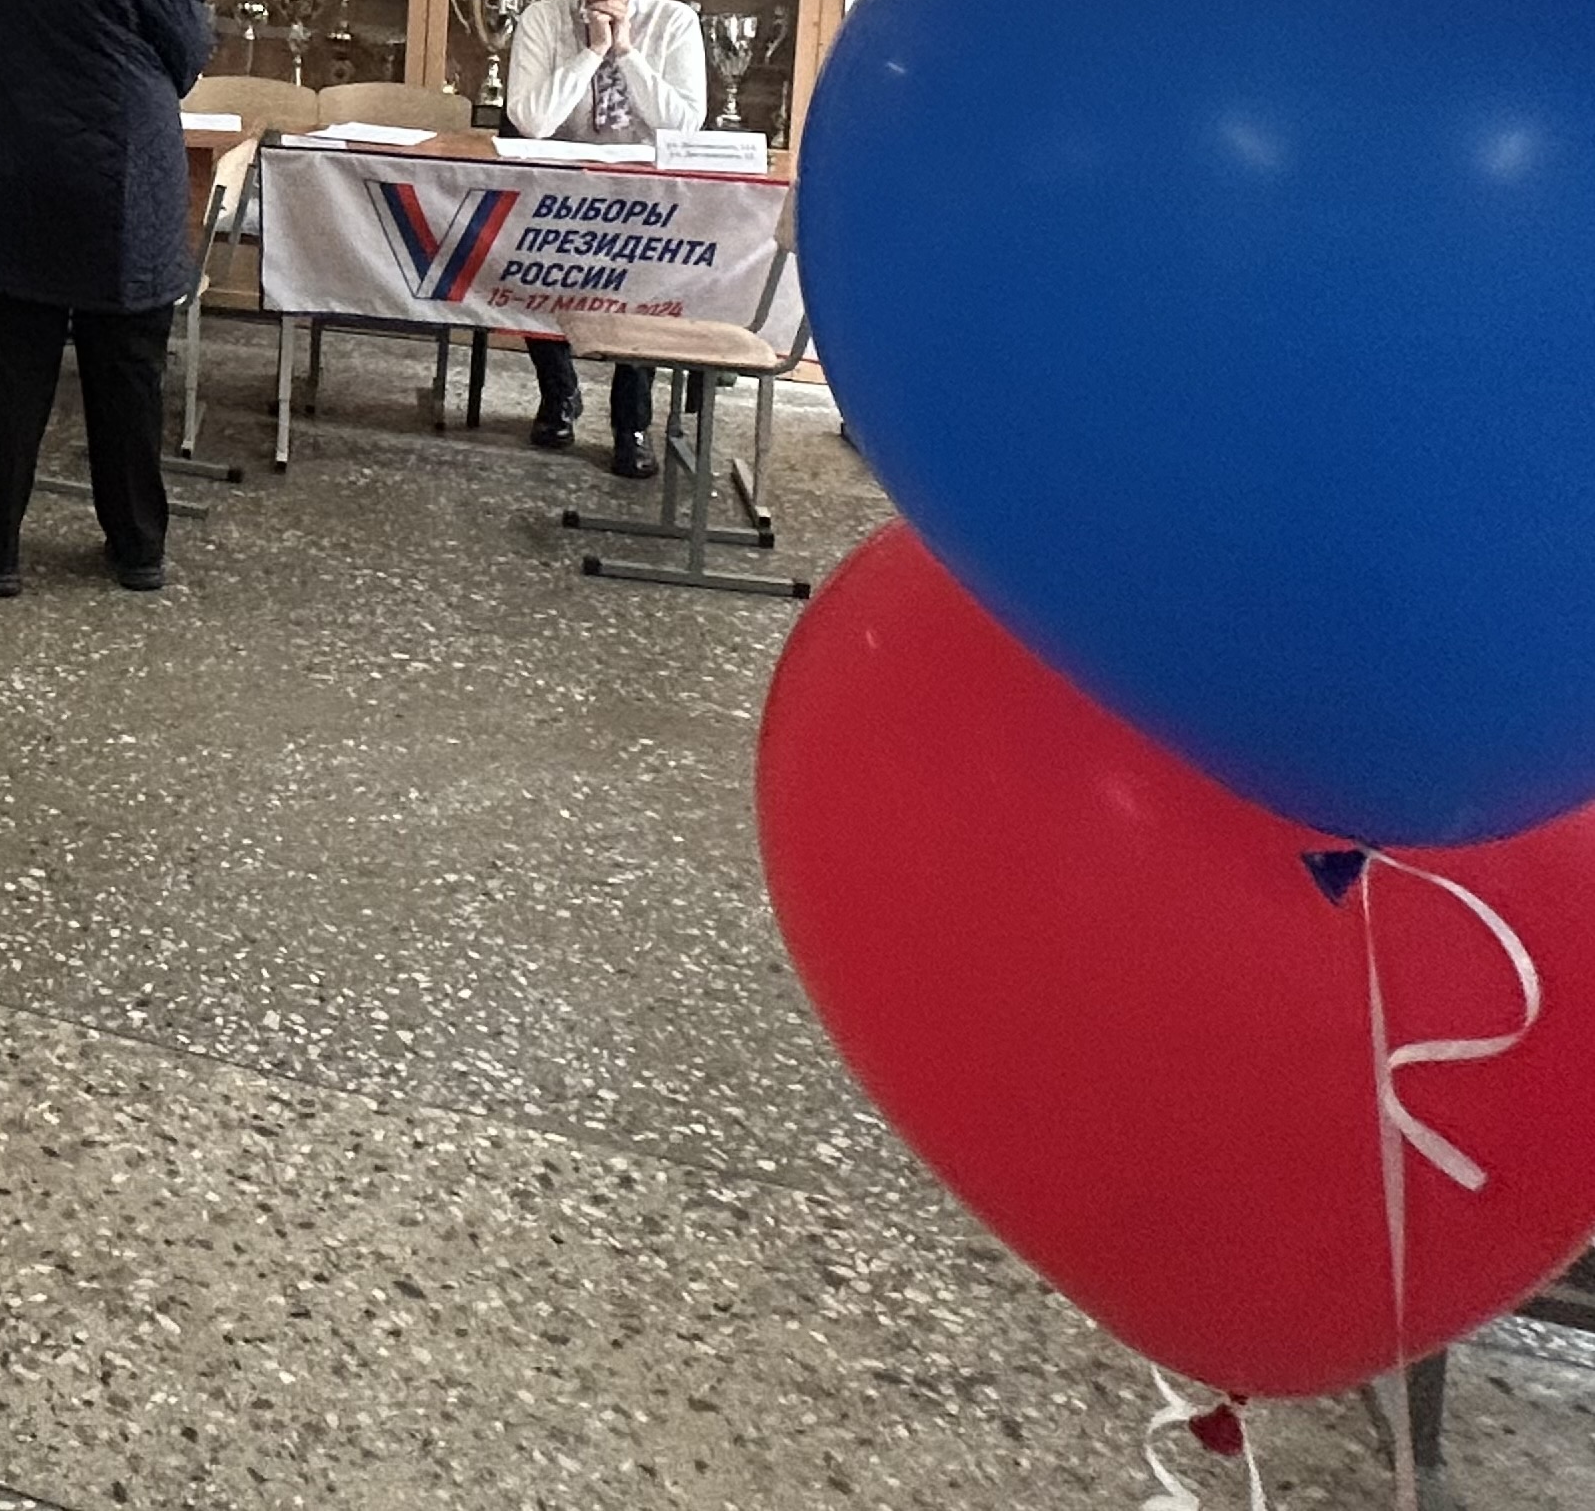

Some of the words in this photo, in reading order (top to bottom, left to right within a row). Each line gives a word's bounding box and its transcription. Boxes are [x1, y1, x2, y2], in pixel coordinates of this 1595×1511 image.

[532, 194, 679, 228] ВЫБОРЫ
[515, 227, 718, 267] ПРЕЗИДЕНТА
[500, 260, 629, 291] РОССИИ
[550, 294, 627, 314] МАРТА
